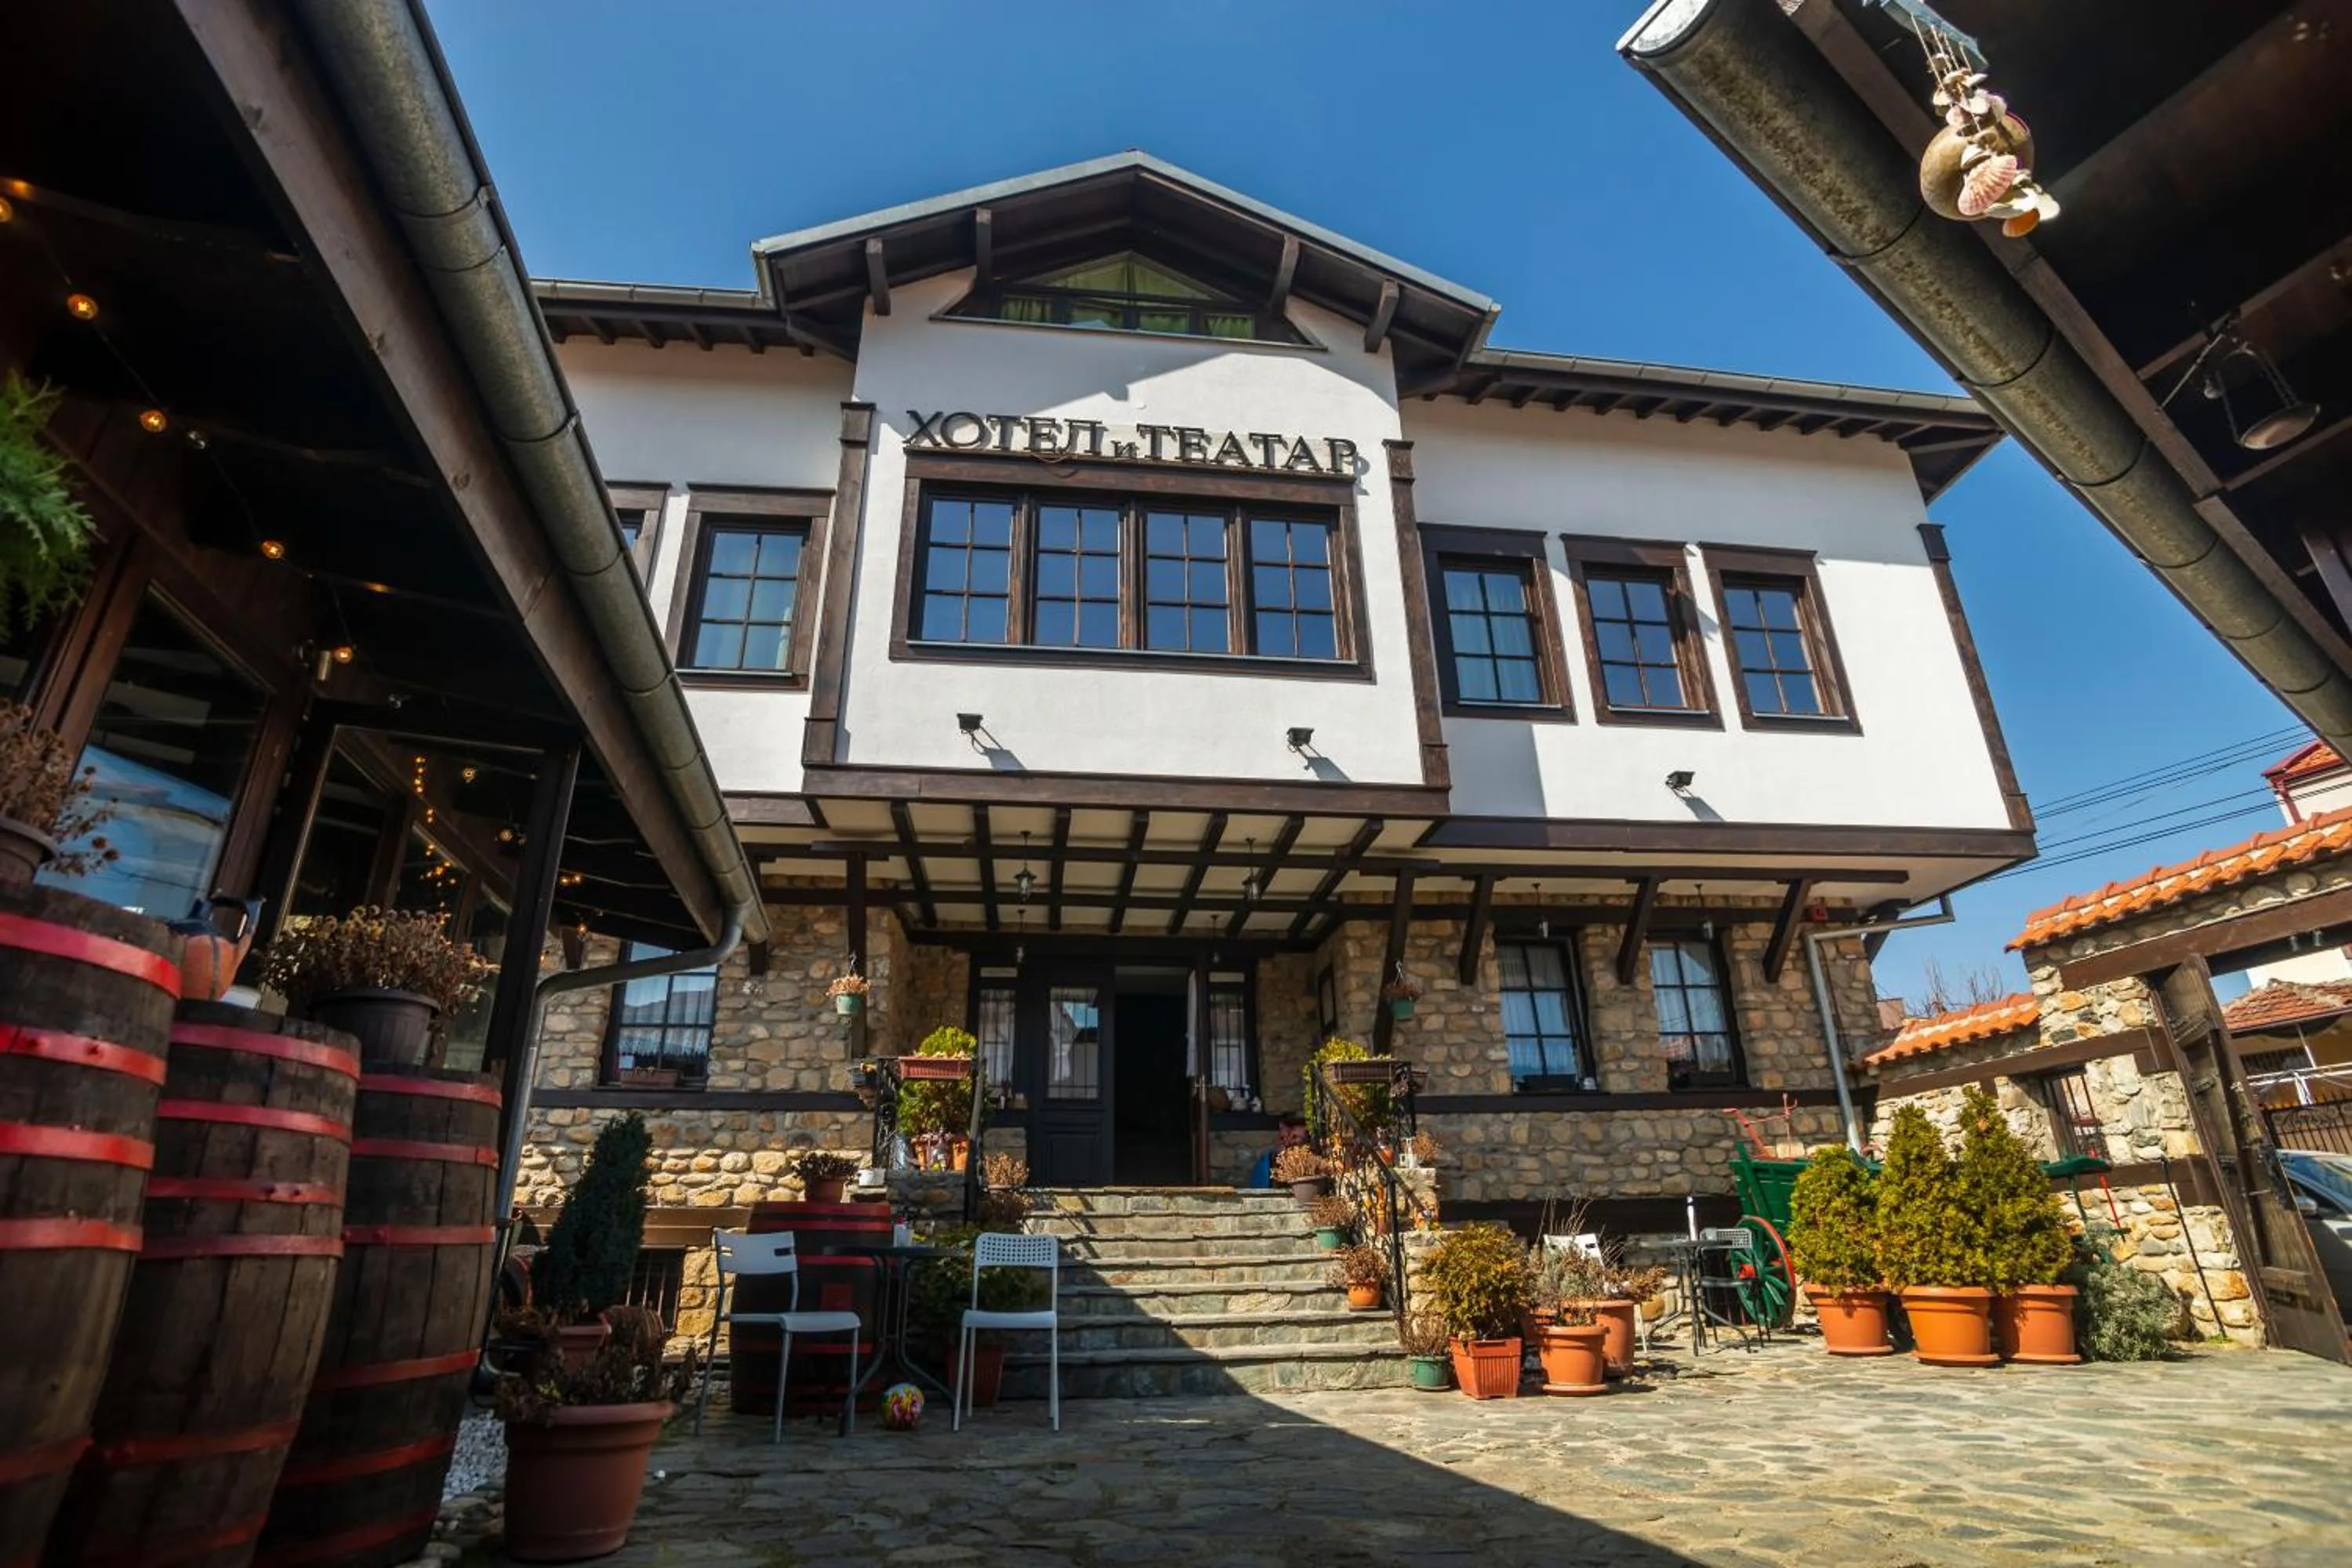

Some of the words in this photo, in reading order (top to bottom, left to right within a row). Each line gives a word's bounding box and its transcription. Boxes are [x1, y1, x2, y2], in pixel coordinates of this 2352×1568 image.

[903, 410, 1102, 456] ХОТЕЛ
[1110, 440, 1137, 458] и
[1136, 423, 1357, 473] ТЕАТАР
